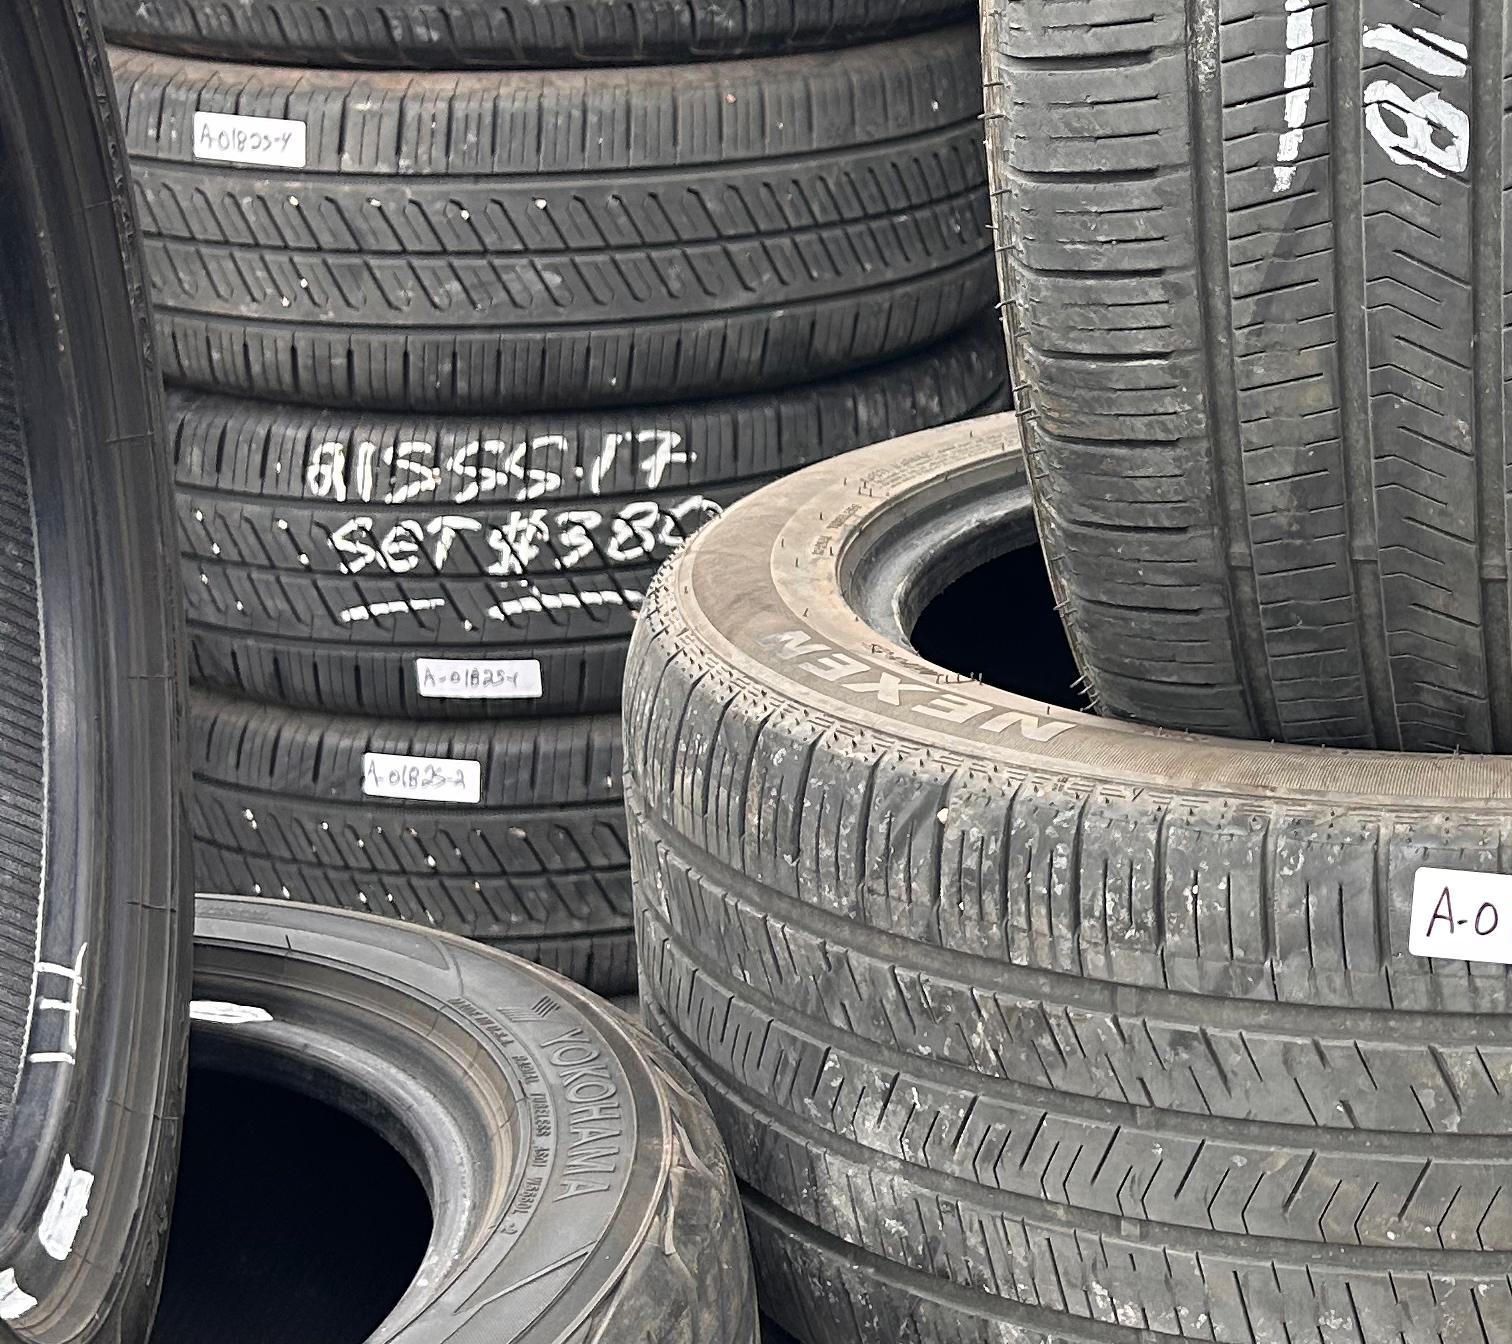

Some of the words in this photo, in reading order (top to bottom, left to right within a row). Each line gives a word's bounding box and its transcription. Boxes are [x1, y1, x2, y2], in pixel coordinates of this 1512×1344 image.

[328, 514, 483, 575] SET
[760, 629, 1078, 743] NEXEN
[540, 1027, 624, 1204] YOKOHAMA
